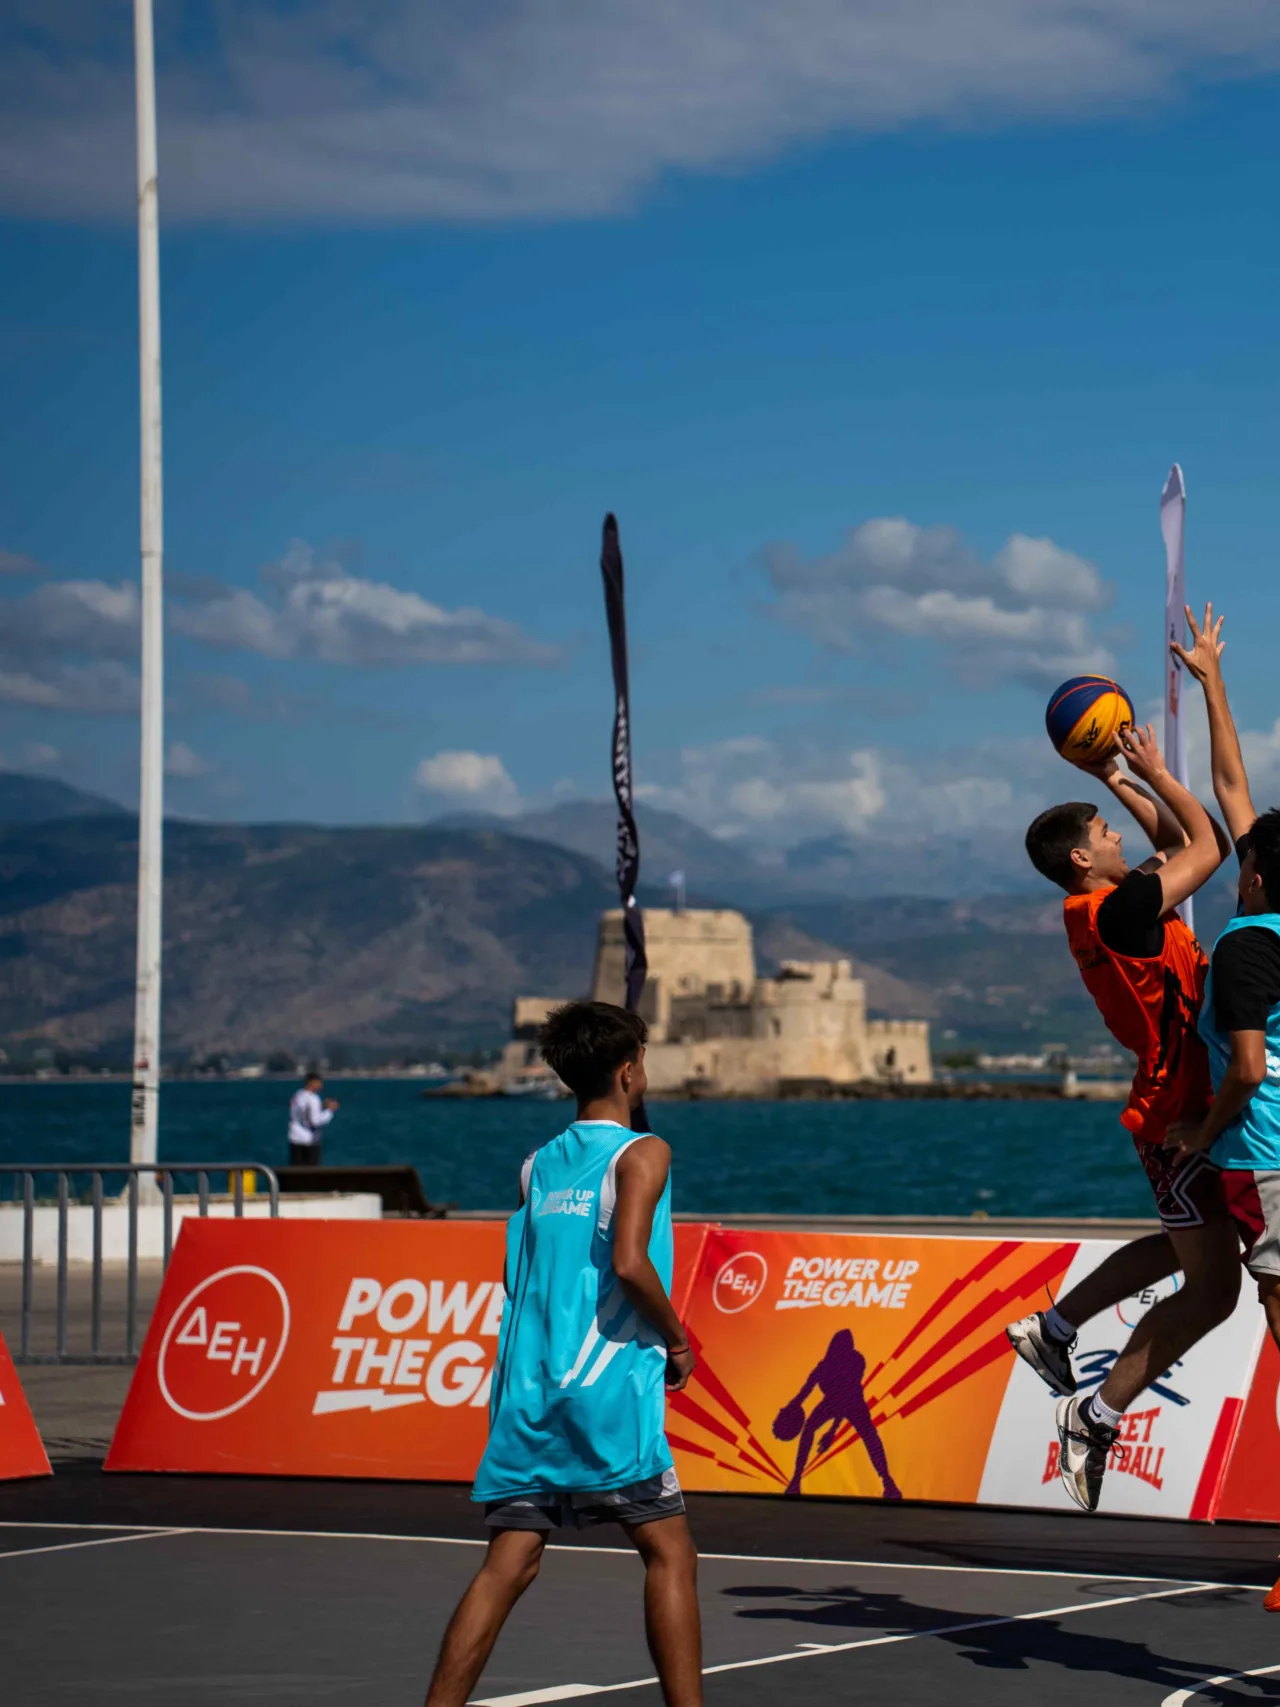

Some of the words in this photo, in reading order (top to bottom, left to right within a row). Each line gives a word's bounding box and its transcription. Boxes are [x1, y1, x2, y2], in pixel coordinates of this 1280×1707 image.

[575, 1189, 595, 1202] UP
[719, 1268, 757, 1296] ΔΕΗ
[786, 1257, 880, 1280] POWER
[882, 1259, 919, 1281] UP
[337, 1278, 505, 1335] POWE
[175, 1307, 266, 1375] ΔΕΗ
